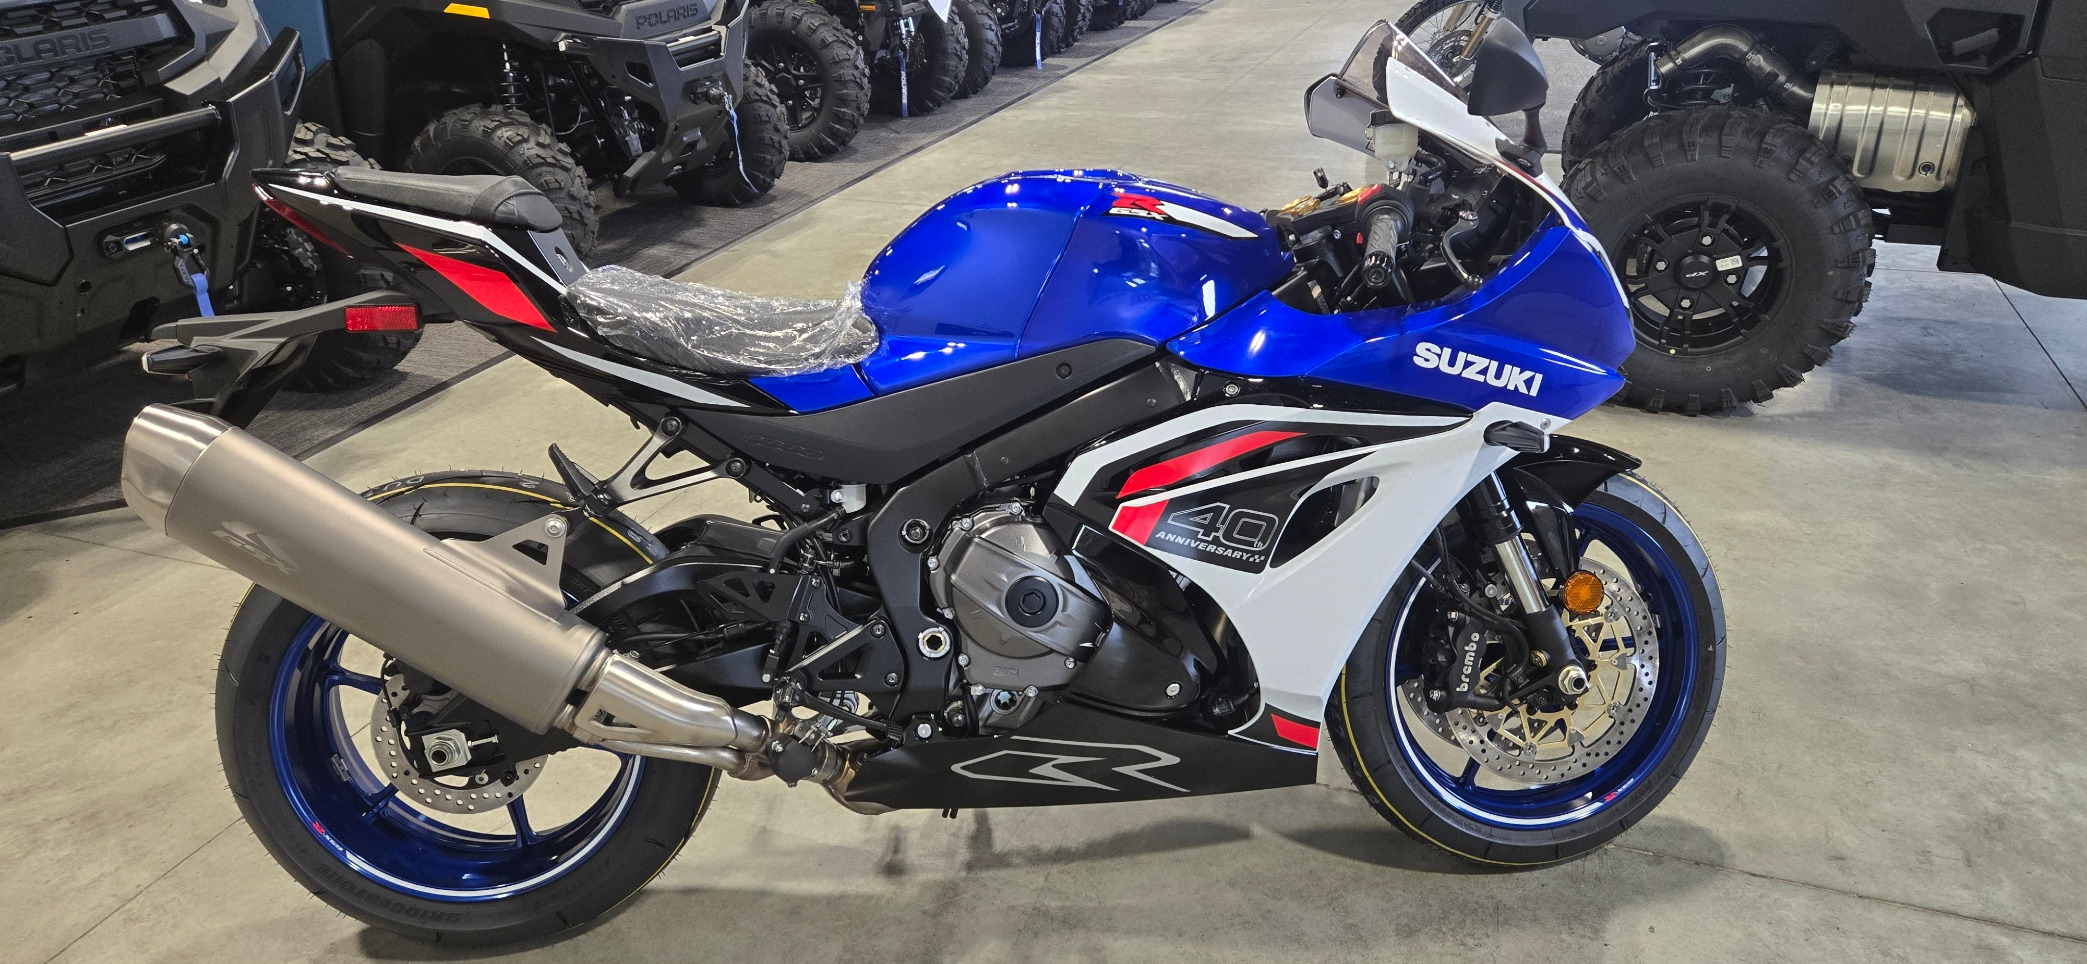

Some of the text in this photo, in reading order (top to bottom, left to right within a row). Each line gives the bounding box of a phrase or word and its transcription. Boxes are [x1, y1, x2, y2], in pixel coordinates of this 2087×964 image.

[635, 3, 699, 30] POLARIS
[0, 28, 112, 68] OLARIS
[900, 70, 908, 104] POLARIS
[1413, 341, 1543, 397] SUZUKI
[1155, 531, 1252, 561] ANNIVERSARY
[1456, 632, 1480, 692] brembo
